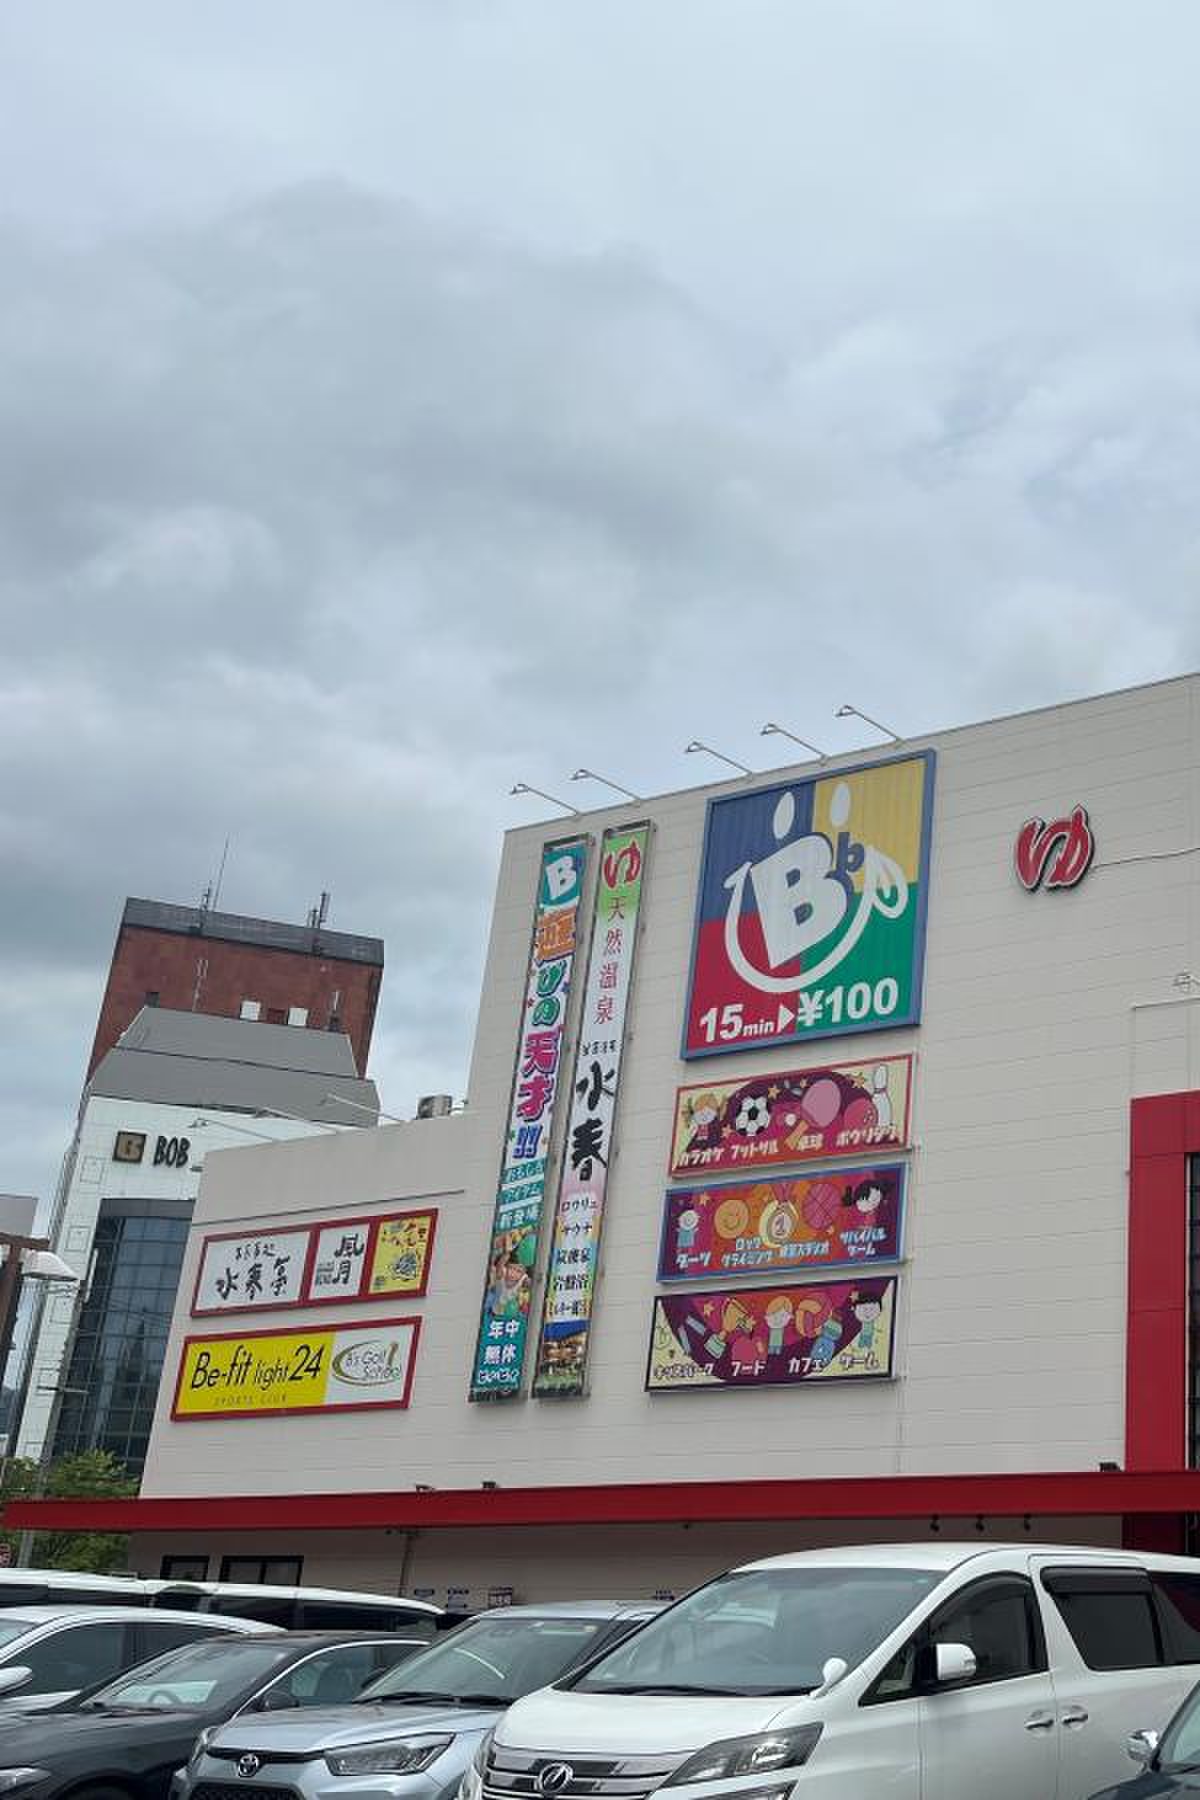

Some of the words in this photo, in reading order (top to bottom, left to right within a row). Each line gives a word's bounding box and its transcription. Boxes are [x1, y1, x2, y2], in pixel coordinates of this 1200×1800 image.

[603, 840, 642, 889] ゆ
[1015, 803, 1094, 892] ゆ
[545, 854, 577, 900] B
[594, 896, 625, 1025] 天然温泉
[700, 1003, 773, 1043] 15min
[796, 977, 898, 1027] ¥100
[571, 1060, 616, 1182] 水春
[153, 1135, 190, 1168] BOB
[677, 1146, 725, 1167] カラオケ
[731, 1140, 778, 1159] フットサル
[561, 1197, 599, 1212] ロウリュ
[332, 1233, 365, 1285] 風月
[676, 1251, 711, 1268] ダーツ
[488, 1319, 520, 1339] 年中
[191, 1344, 253, 1389] Be-fit
[732, 1360, 767, 1377] フード
